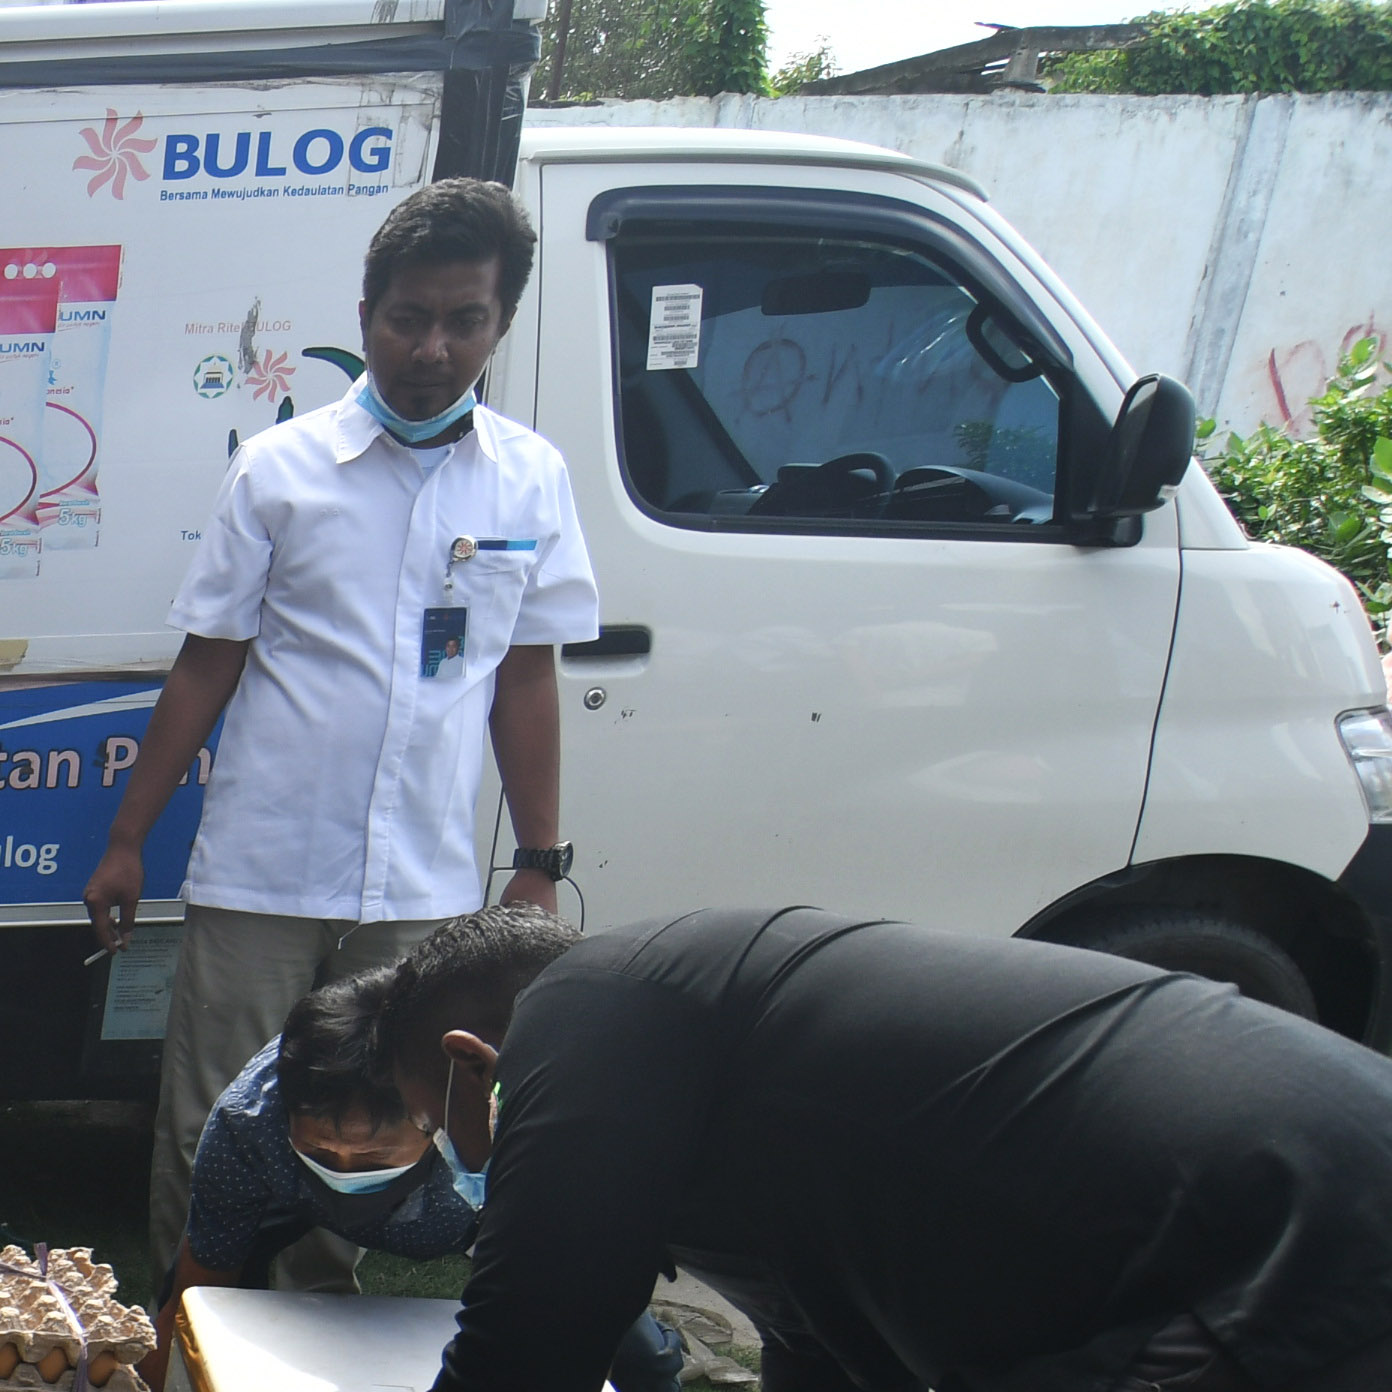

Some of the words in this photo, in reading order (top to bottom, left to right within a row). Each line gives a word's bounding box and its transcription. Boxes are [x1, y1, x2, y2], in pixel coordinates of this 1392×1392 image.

[162, 127, 394, 181] BULOG
[160, 189, 209, 201] Bersama
[211, 186, 280, 201] Mewujudkan
[283, 184, 344, 197] Kedaulatan
[348, 184, 389, 197] Pangan
[184, 322, 214, 334] Mitra
[180, 530, 202, 541] Tok
